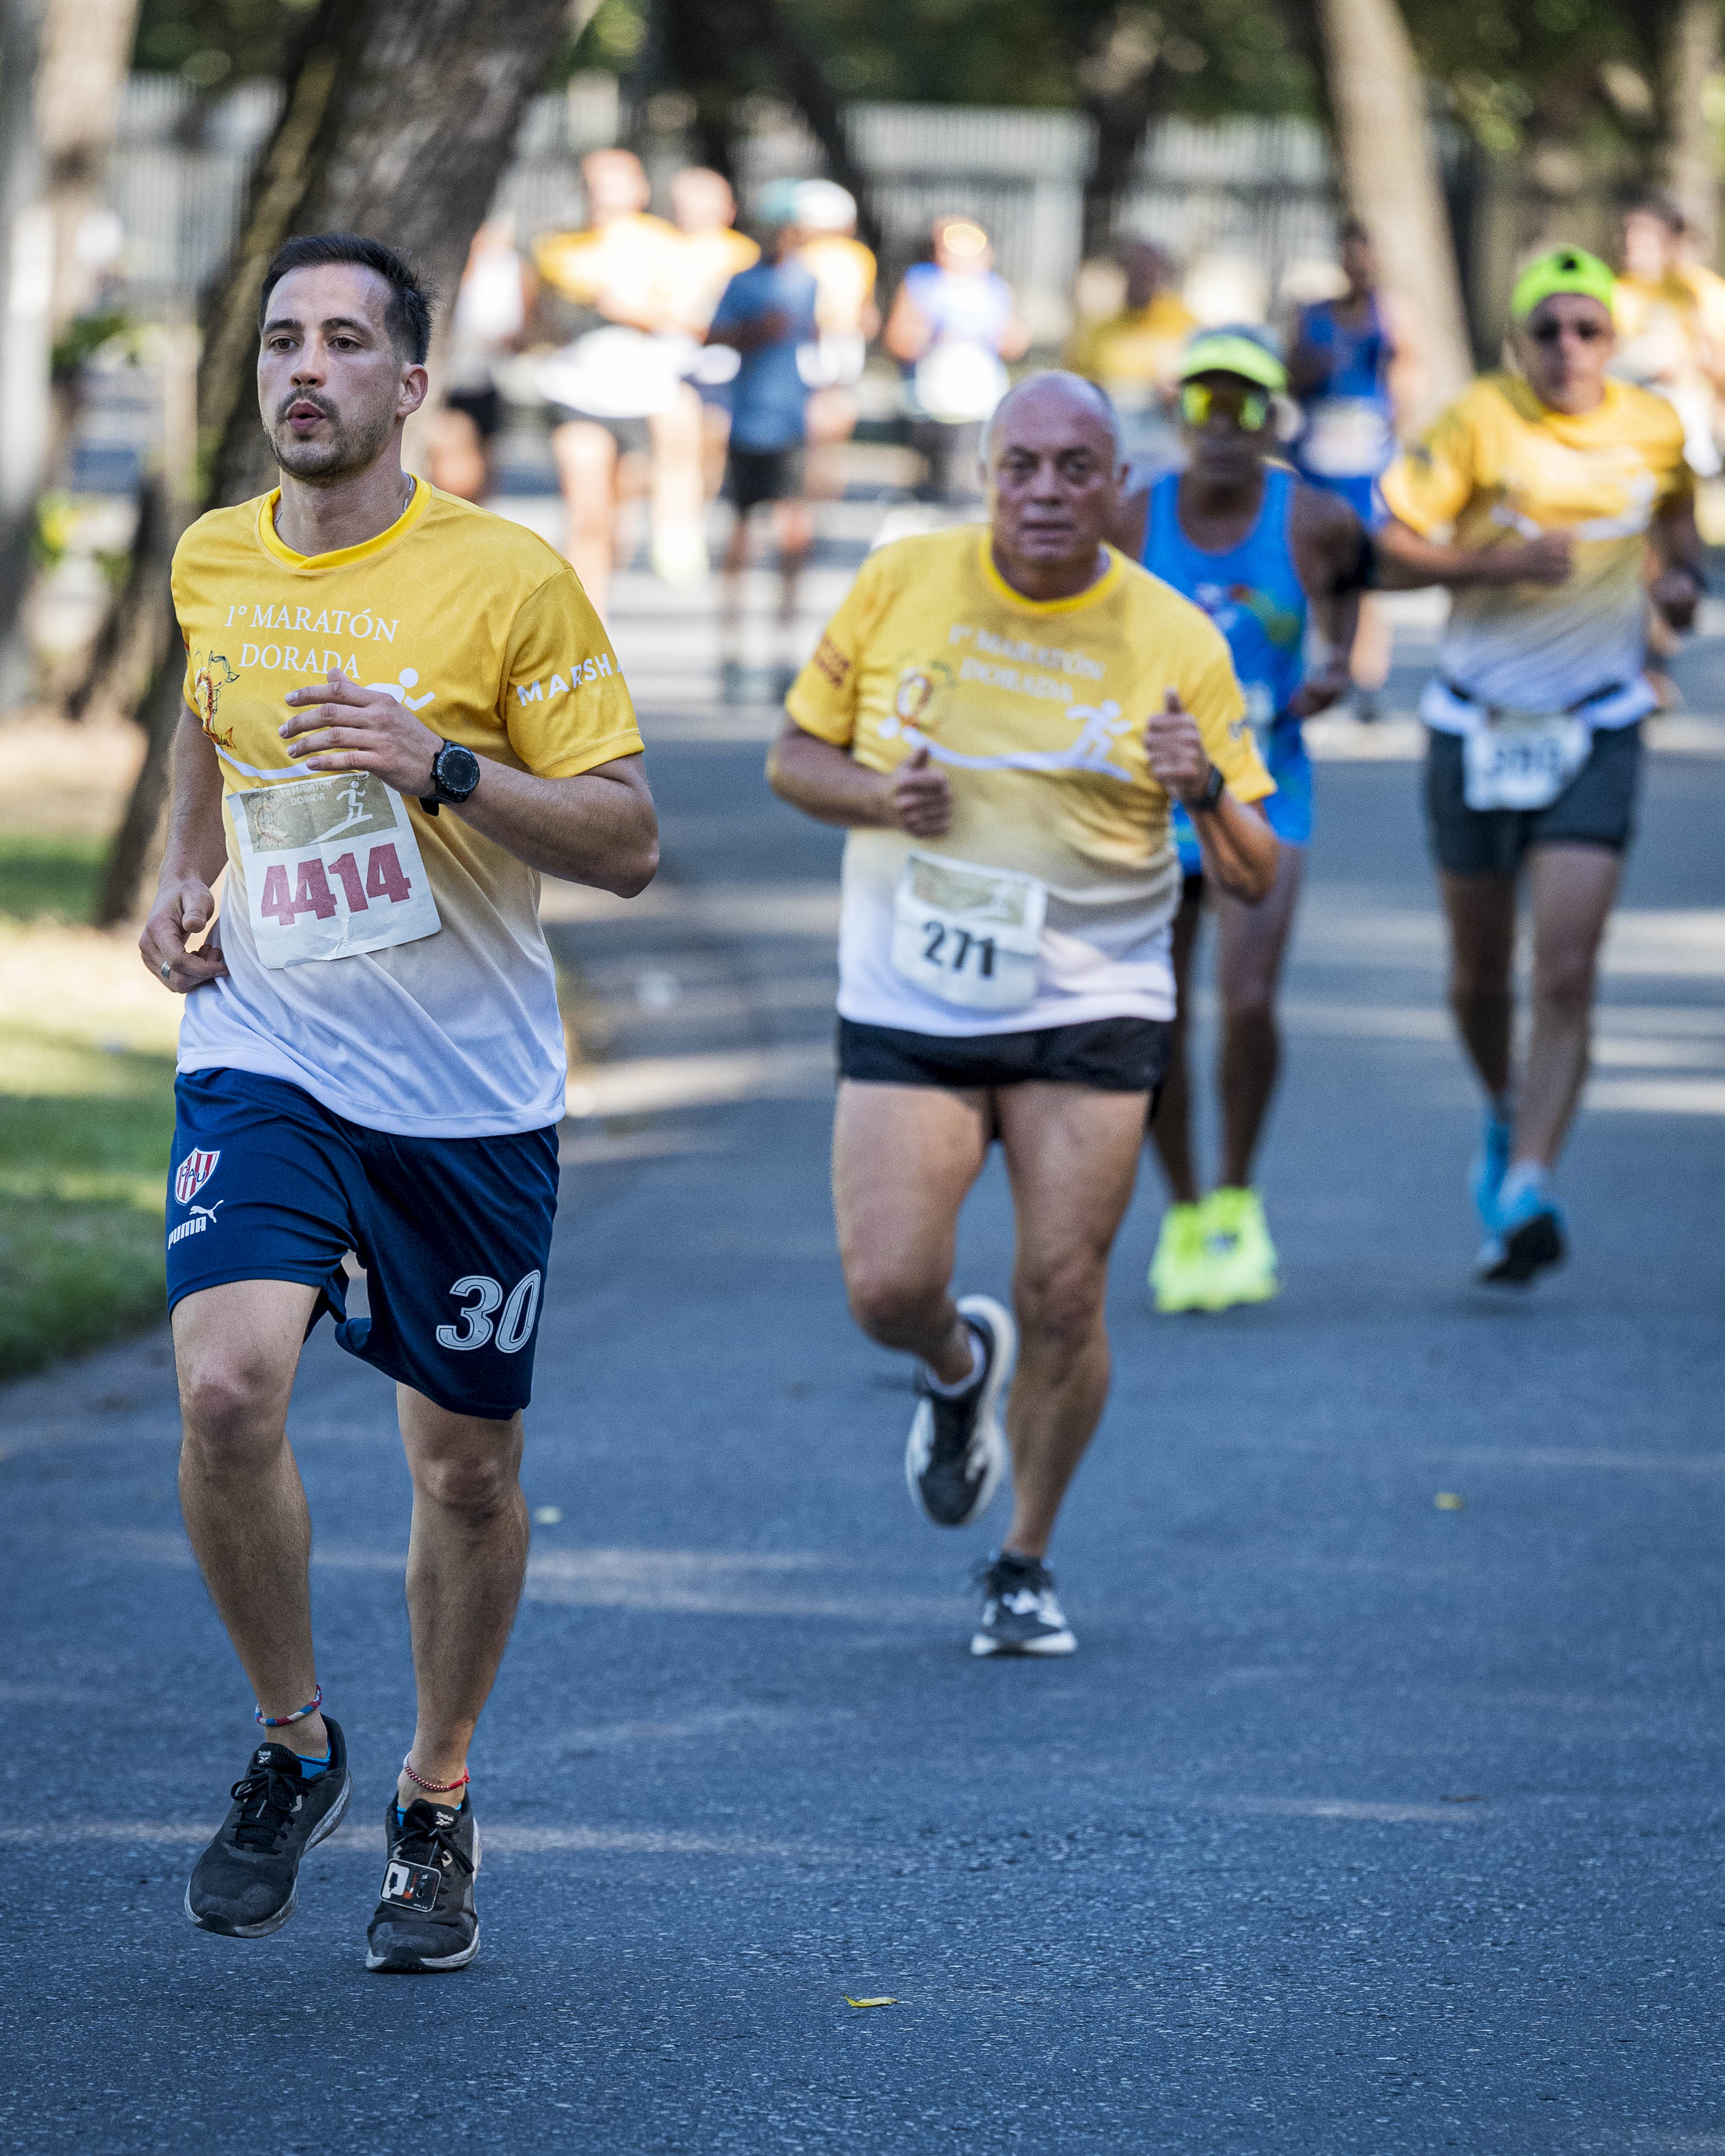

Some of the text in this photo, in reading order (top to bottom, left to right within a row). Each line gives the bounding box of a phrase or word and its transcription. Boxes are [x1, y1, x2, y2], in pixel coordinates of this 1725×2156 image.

[250, 604, 400, 643] MARATÓN
[238, 643, 361, 679] DORADA
[291, 793, 326, 806] DORADA
[261, 842, 412, 926] 4414
[923, 920, 995, 978] 271
[181, 1165, 207, 1183] CAU
[168, 1216, 206, 1251] PUMA
[436, 1269, 541, 1353] 30
